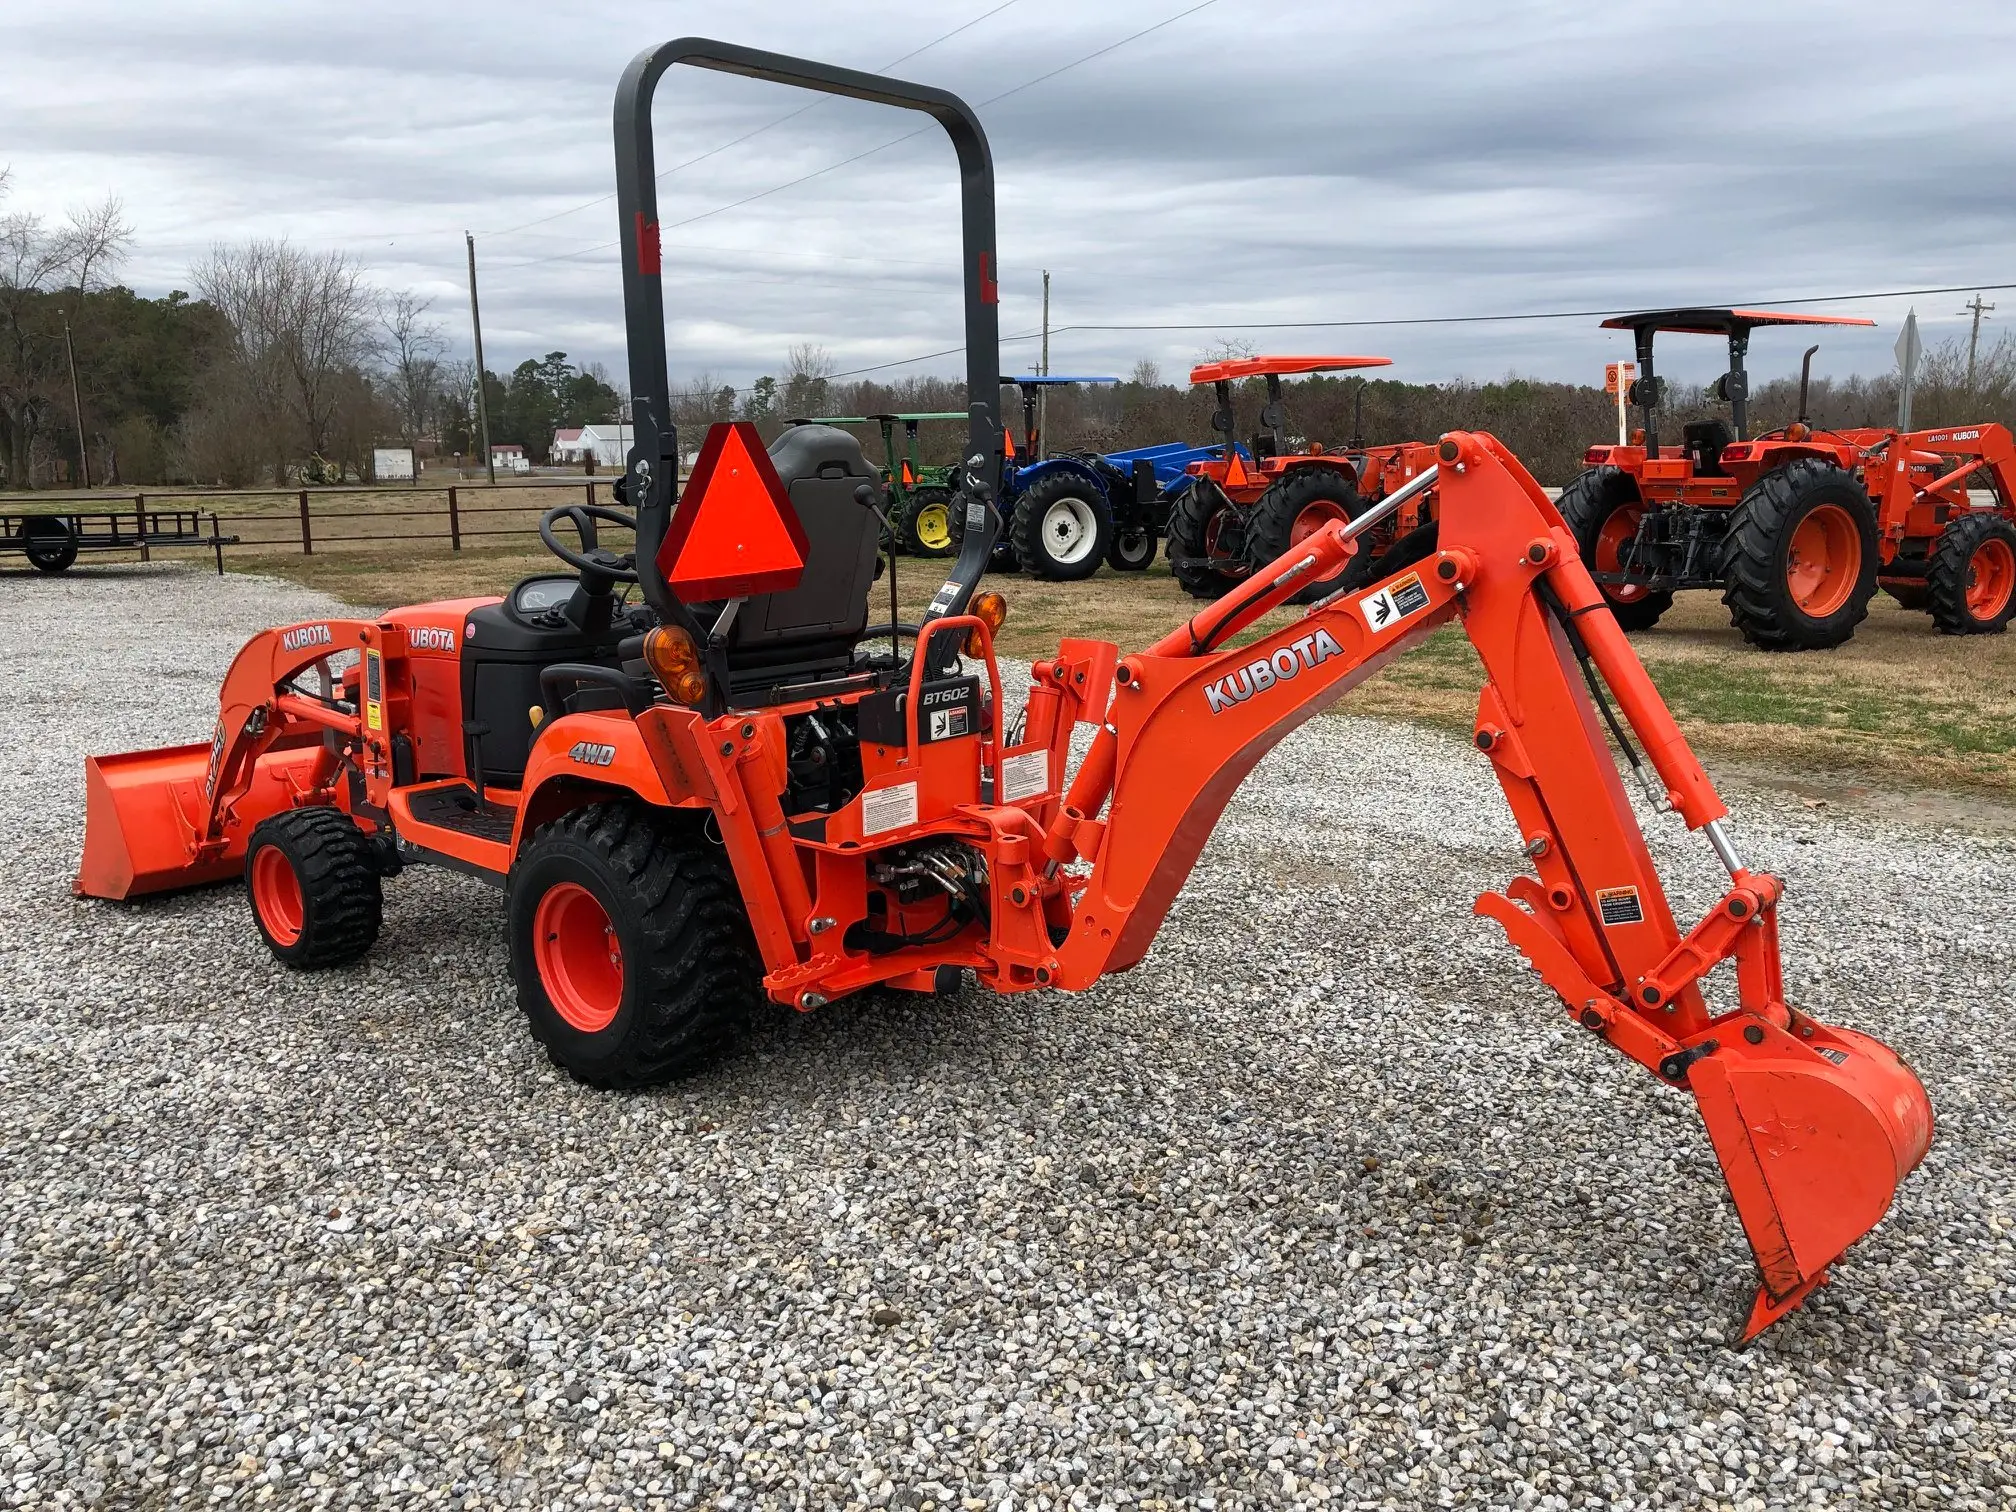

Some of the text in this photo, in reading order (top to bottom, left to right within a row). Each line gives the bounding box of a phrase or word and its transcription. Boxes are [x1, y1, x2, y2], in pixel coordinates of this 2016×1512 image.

[1952, 430, 1980, 441] KUBOTA
[283, 624, 332, 651] KUBOTA
[408, 627, 456, 652] UBOTA
[1203, 627, 1345, 714] KUBOTA
[923, 686, 970, 706] BT602
[568, 741, 616, 767] 4WD
